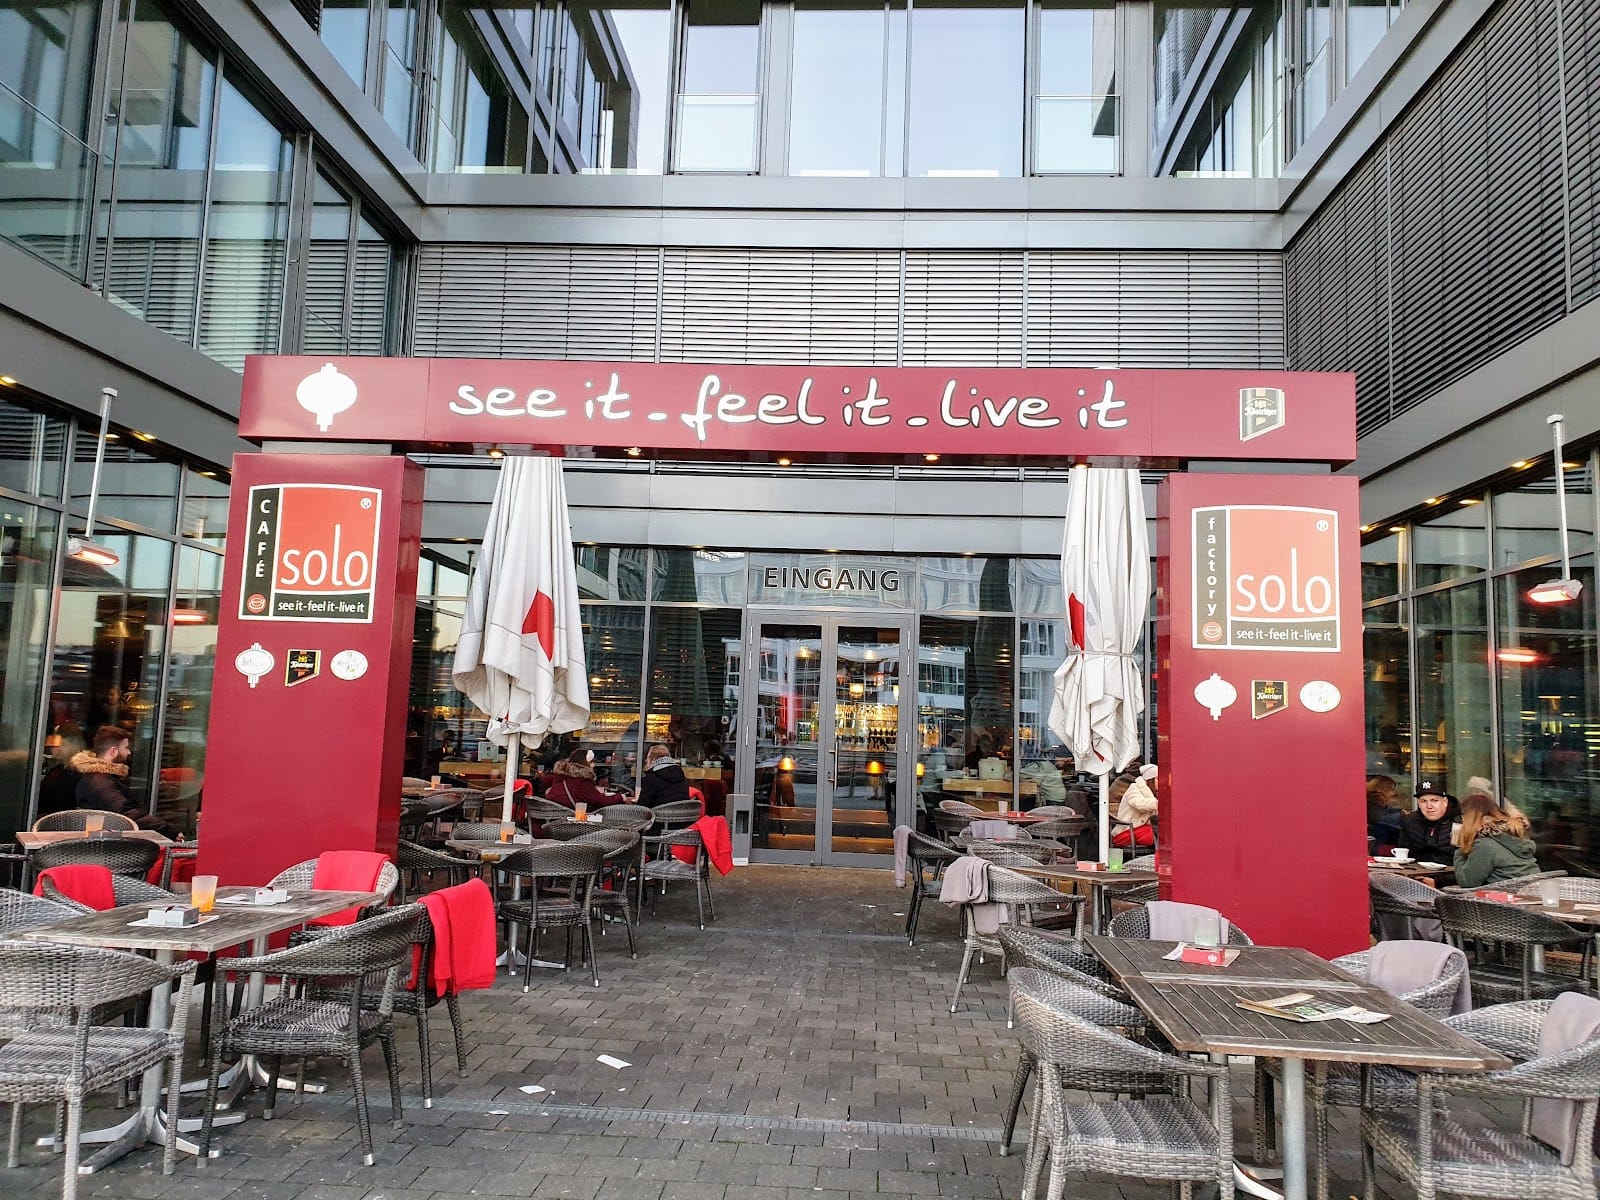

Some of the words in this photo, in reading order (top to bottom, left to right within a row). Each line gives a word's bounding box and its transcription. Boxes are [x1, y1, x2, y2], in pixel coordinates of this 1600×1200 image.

[448, 384, 567, 418] see
[584, 372, 631, 420] it
[680, 373, 827, 441] feel
[842, 376, 892, 426] it
[940, 378, 1061, 428] live
[1077, 378, 1129, 429] it
[255, 499, 271, 578] CAFÉ
[280, 523, 369, 587] solo
[1206, 516, 1217, 616] factory
[277, 601, 295, 611] see
[356, 602, 365, 613] it
[763, 566, 900, 592] EINGANG
[1235, 546, 1332, 614] solo
[1236, 629, 1254, 639] see
[1323, 630, 1332, 641] it
